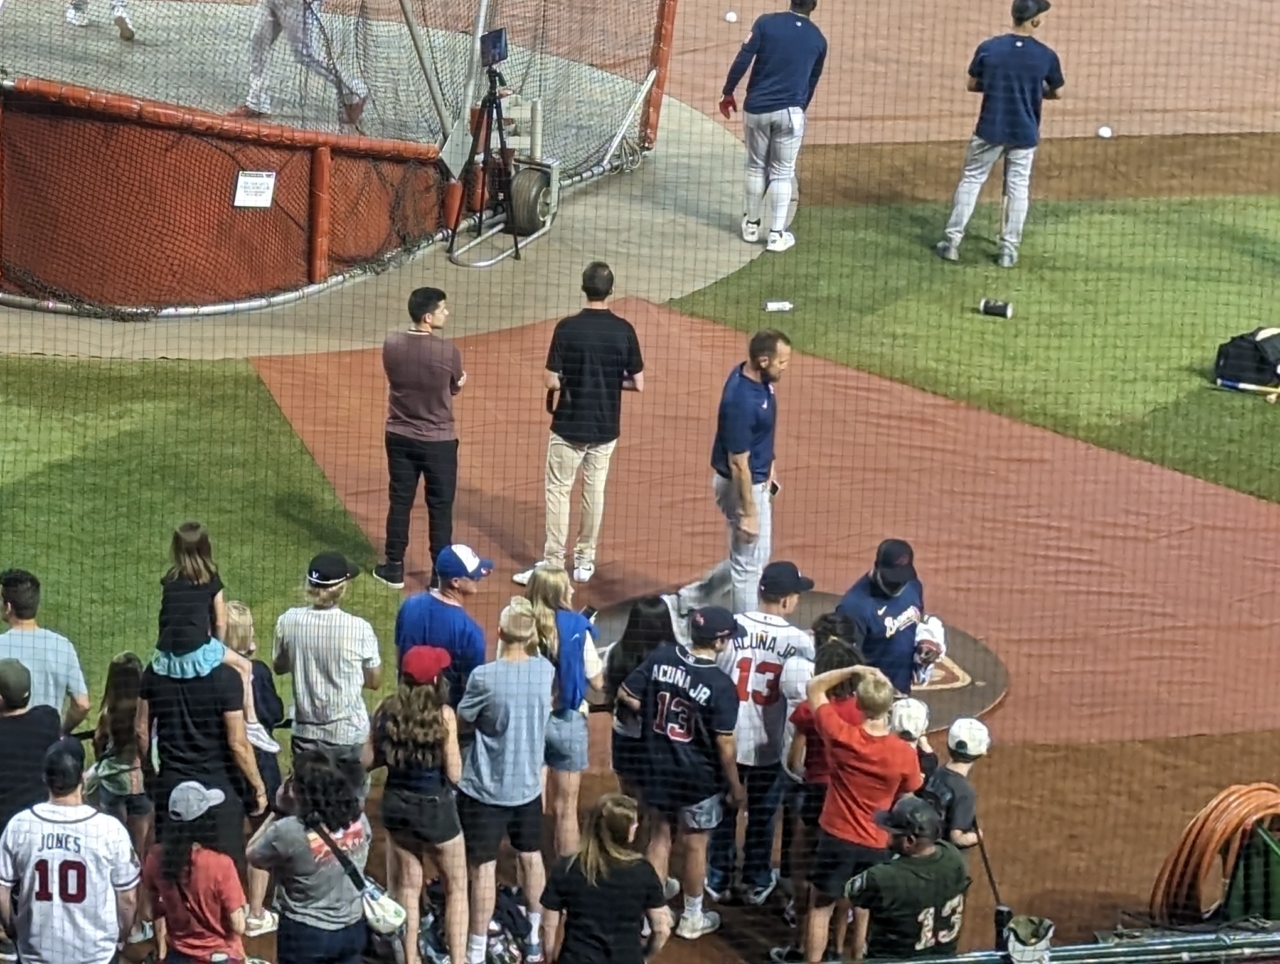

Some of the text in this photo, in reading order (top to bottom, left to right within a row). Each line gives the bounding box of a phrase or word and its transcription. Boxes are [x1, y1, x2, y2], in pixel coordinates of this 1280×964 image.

[651, 664, 691, 694] ACUÑA
[735, 656, 783, 707] 13
[652, 691, 696, 743] 13
[37, 832, 82, 854] JONES
[34, 858, 87, 905] 10
[914, 893, 964, 951] 13
